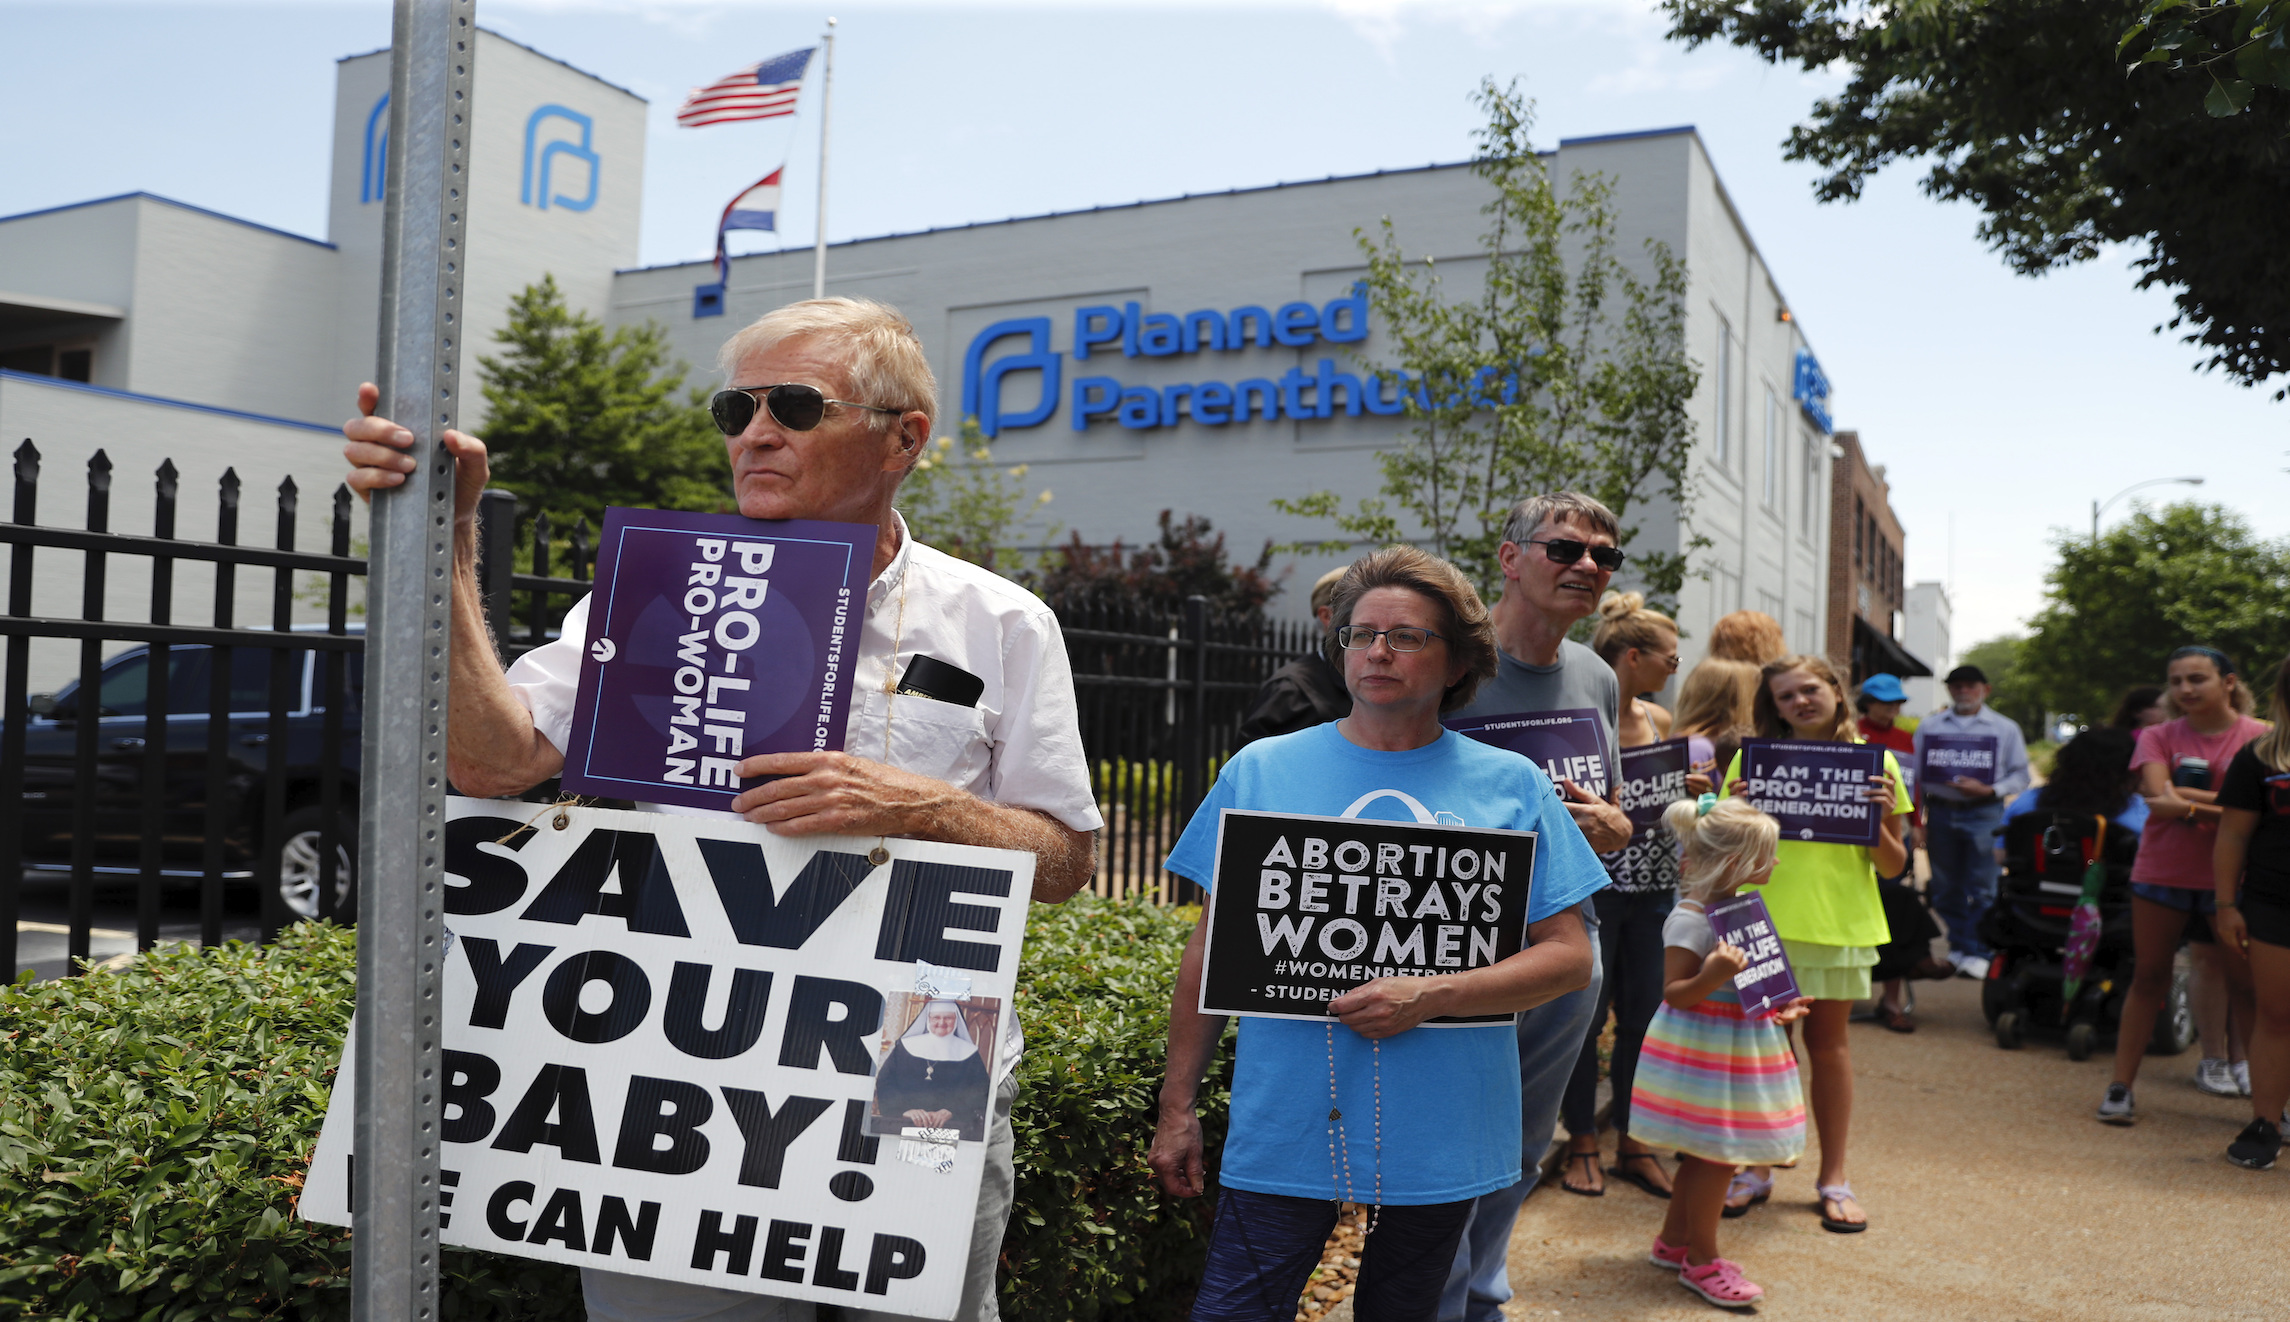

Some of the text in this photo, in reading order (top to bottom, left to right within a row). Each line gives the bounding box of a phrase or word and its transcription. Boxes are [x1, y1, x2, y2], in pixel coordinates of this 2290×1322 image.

[1073, 280, 1370, 360] Planned
[663, 538, 728, 785] PRO-WOMAN
[699, 541, 776, 789] PRO-LIFE
[1484, 716, 1573, 731] STUDENTSFORLIFE.ORG
[1749, 778, 1872, 803] PRO-LIFE
[1755, 764, 1865, 783] I AM THE
[1750, 798, 1868, 820] GENERATION
[1262, 835, 1506, 883] ABORTION
[443, 815, 1014, 972] SAVE
[1257, 868, 1503, 923] BETRAYS
[1256, 913, 1499, 967] WOMEN
[1726, 928, 1745, 946] AM
[1744, 919, 1770, 939] THE
[1264, 984, 1351, 1002] STUDEN
[1733, 956, 1786, 990] GENERATION
[460, 935, 884, 1076] YOUR
[440, 1049, 879, 1203] BABY!
[486, 1180, 662, 1262] CAN
[690, 1208, 927, 1296] HELP
